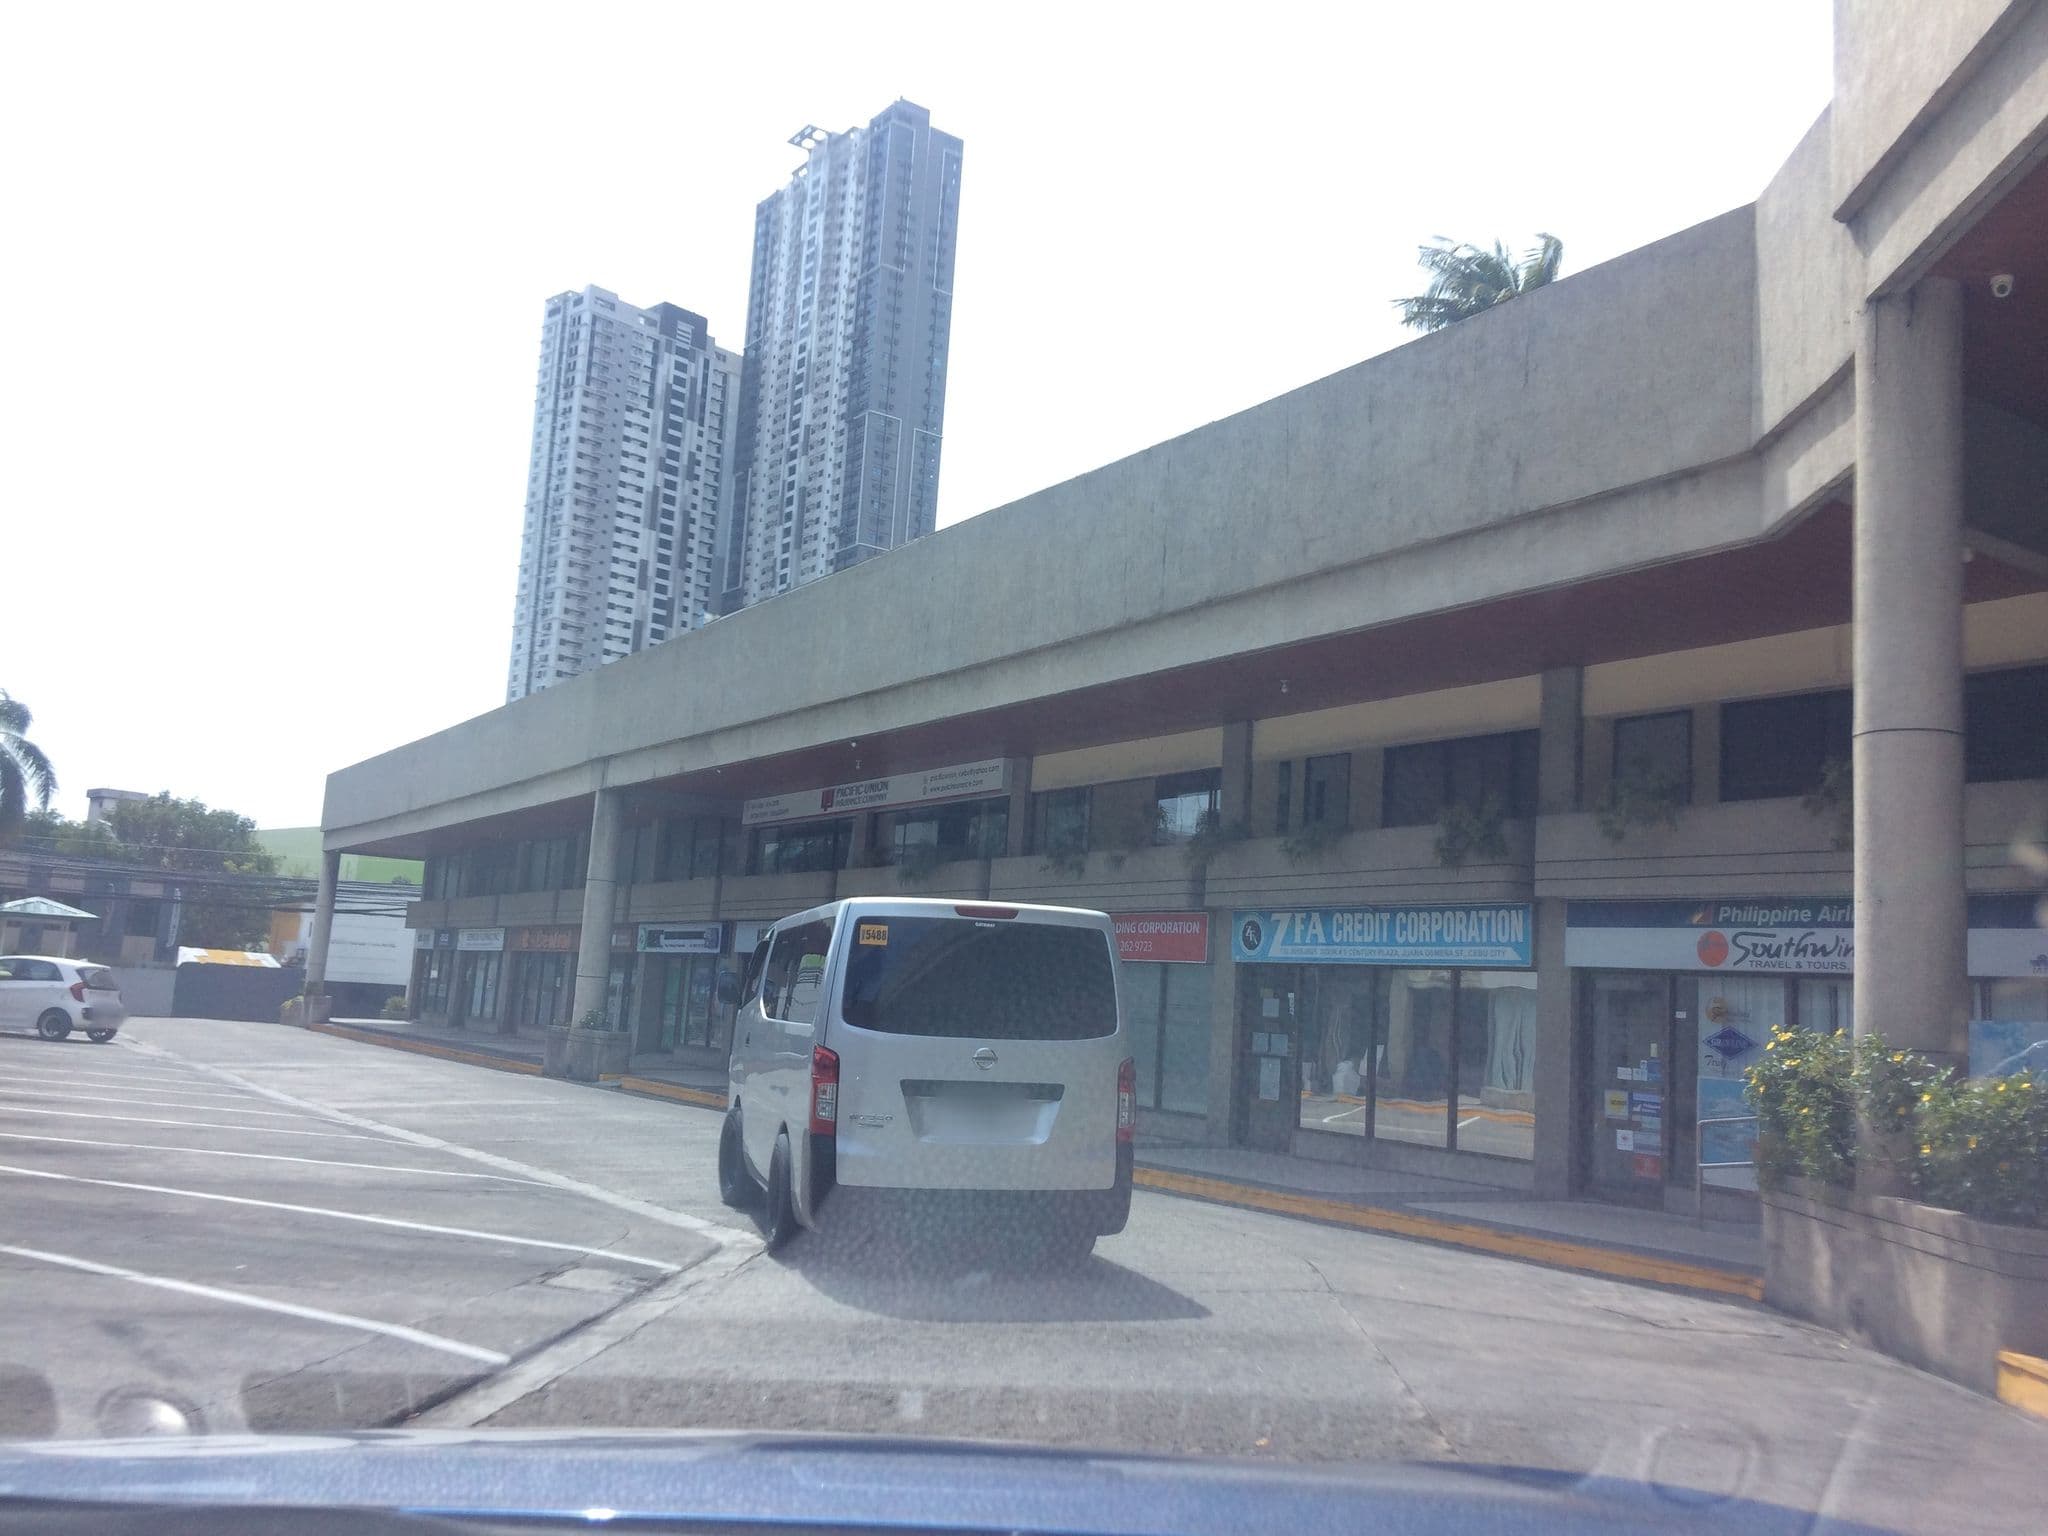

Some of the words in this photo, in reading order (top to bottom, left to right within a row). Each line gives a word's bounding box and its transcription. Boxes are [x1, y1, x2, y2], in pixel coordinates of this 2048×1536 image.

[864, 781, 889, 793] UNION
[1718, 905, 1812, 925] Philippine
[1818, 905, 1855, 922] Airl
[1139, 921, 1200, 934] CORPORATION
[1268, 911, 1328, 957] ZFA
[1332, 911, 1391, 943] CREDIT
[1395, 909, 1524, 943] CORPORATION
[866, 929, 887, 941] 5488
[1731, 931, 1855, 967] Southwin
[1750, 960, 1792, 969] TRAVEL
